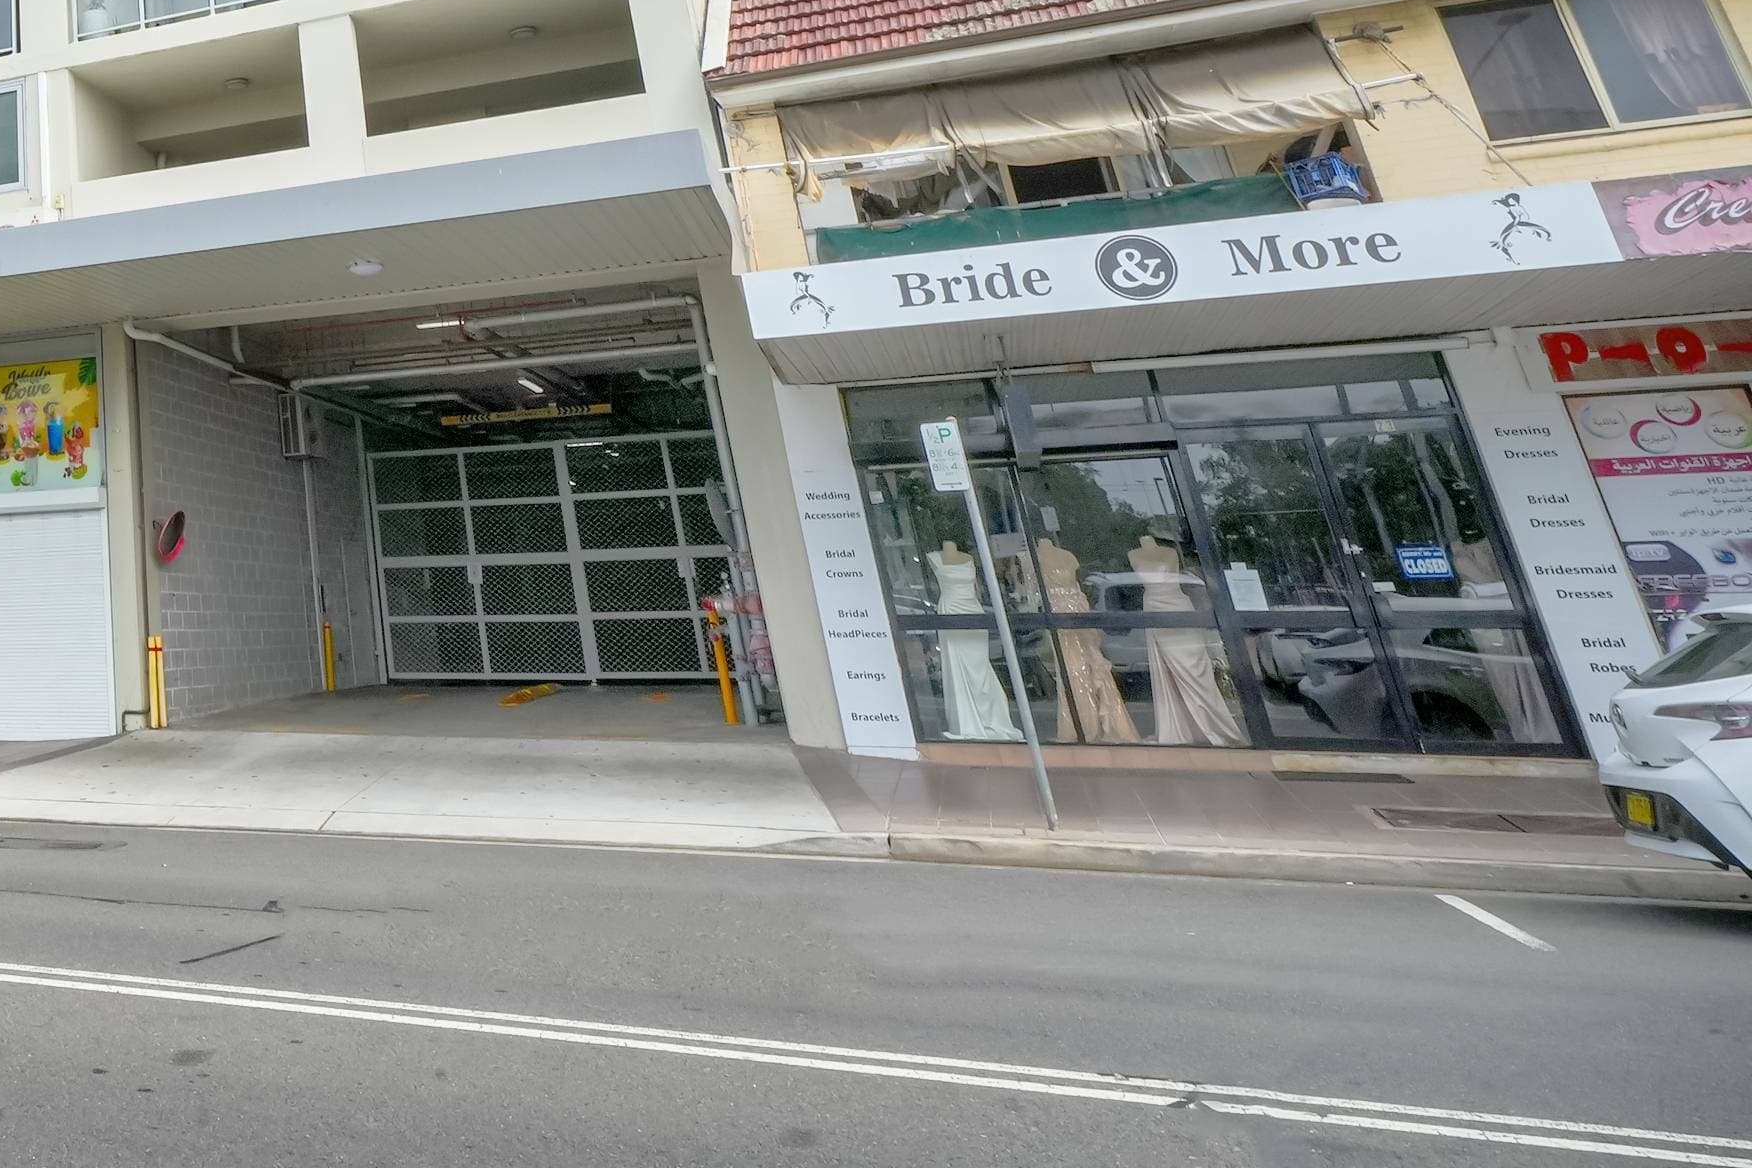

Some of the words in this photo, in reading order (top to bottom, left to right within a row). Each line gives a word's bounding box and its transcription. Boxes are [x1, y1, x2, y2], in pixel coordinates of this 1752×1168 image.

[1655, 183, 1752, 235] Cre
[892, 262, 1053, 308] Bride
[1111, 248, 1167, 289] &
[1221, 231, 1402, 277] More
[938, 427, 951, 444] P
[1494, 425, 1551, 437] Evening
[1504, 449, 1559, 459] Dresses
[1612, 458, 1656, 474] العربية
[1659, 456, 1711, 472] القنوات
[805, 492, 851, 501] Wedding
[1527, 493, 1570, 505] Bridal
[804, 510, 861, 520] Accessories
[1529, 518, 1586, 528] Dresses
[825, 549, 856, 558] Bridal
[1404, 558, 1449, 574] CLOSED
[1534, 564, 1618, 575] Bridesmaid
[825, 570, 864, 579] Crowns
[1635, 573, 1752, 592] FREEBO
[1556, 589, 1614, 599] Dresses
[837, 609, 869, 618] Bridal
[828, 629, 888, 639] HeadPieces
[1581, 638, 1626, 648] Bridal
[1589, 662, 1637, 673] Robes
[846, 670, 887, 681] Earings
[851, 712, 900, 722] Bracelets
